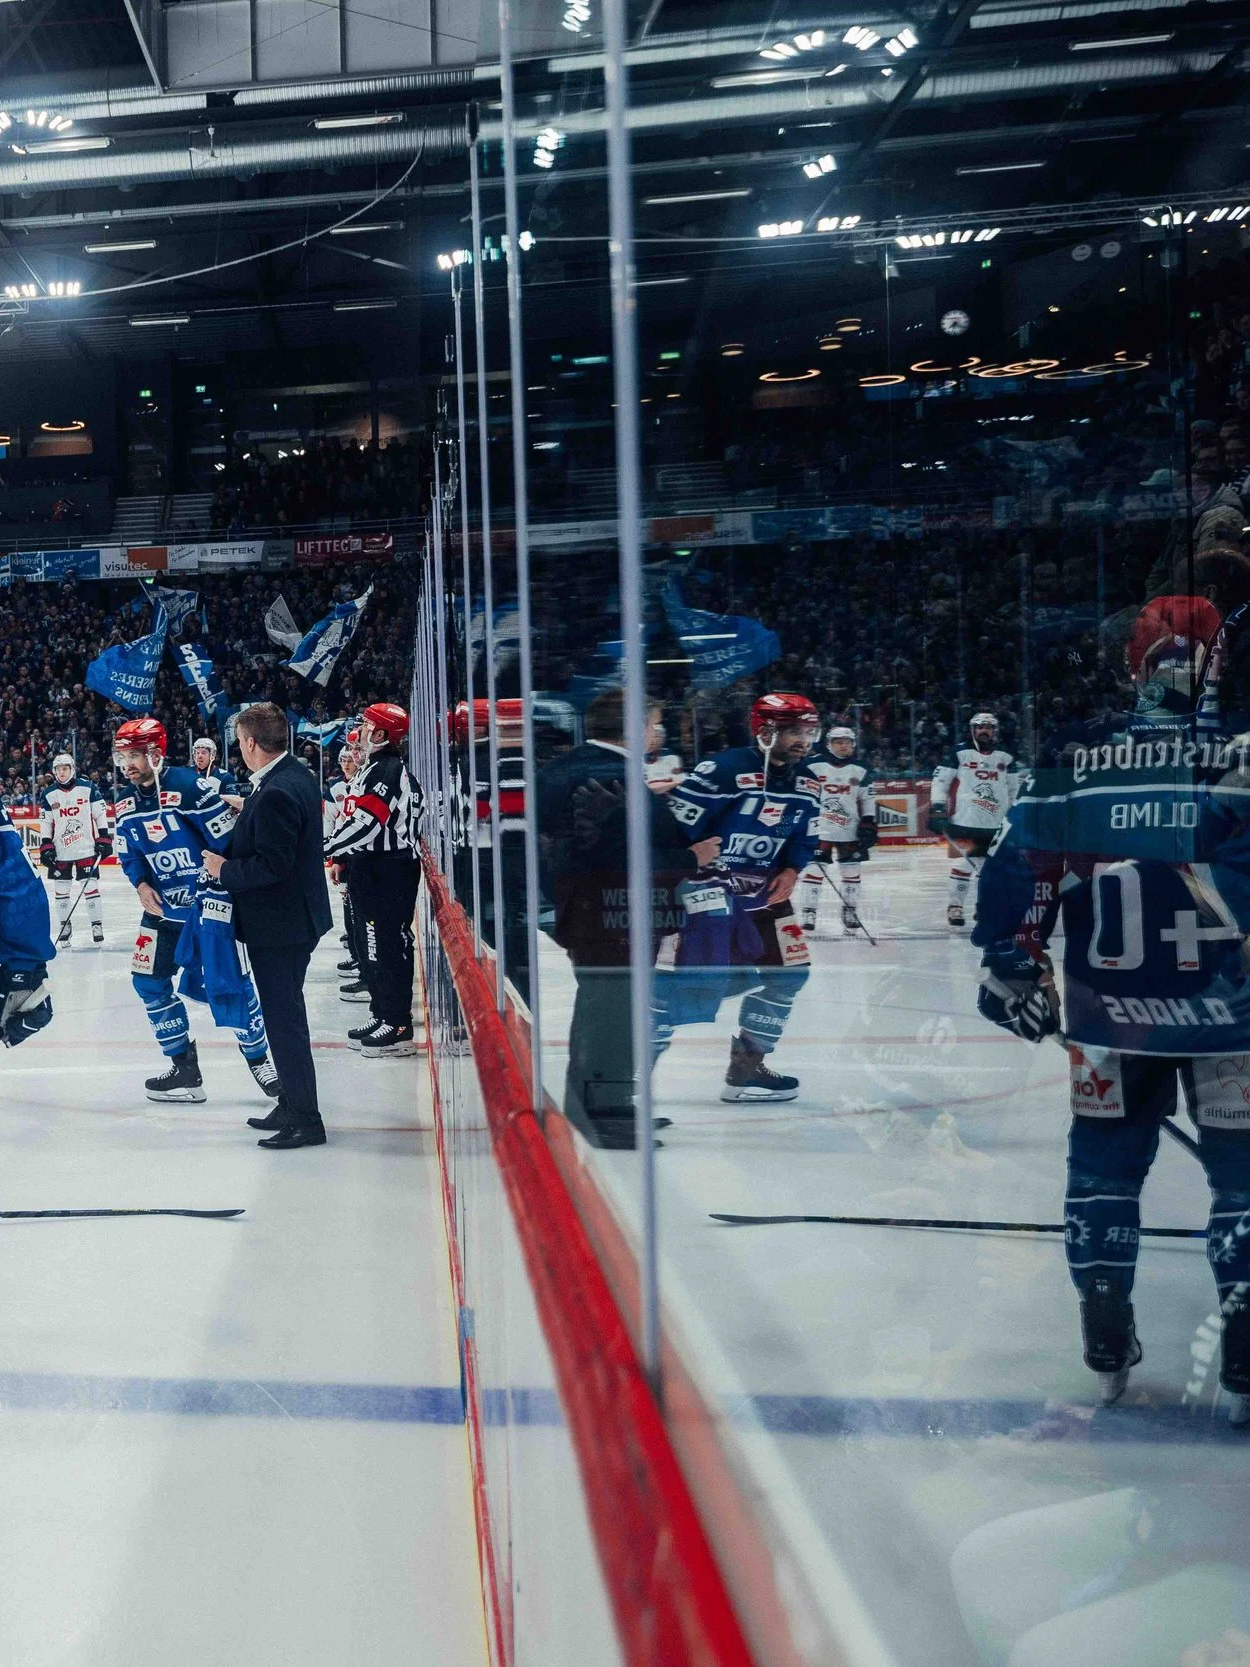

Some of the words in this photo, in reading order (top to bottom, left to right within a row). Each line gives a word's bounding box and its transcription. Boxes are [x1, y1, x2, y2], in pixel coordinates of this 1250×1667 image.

[211, 546, 256, 556] PETEK
[105, 561, 149, 572] visutec
[373, 781, 389, 797] 45
[60, 807, 80, 817] NCP
[602, 888, 668, 906] WEER
[602, 910, 686, 929] WOBAU
